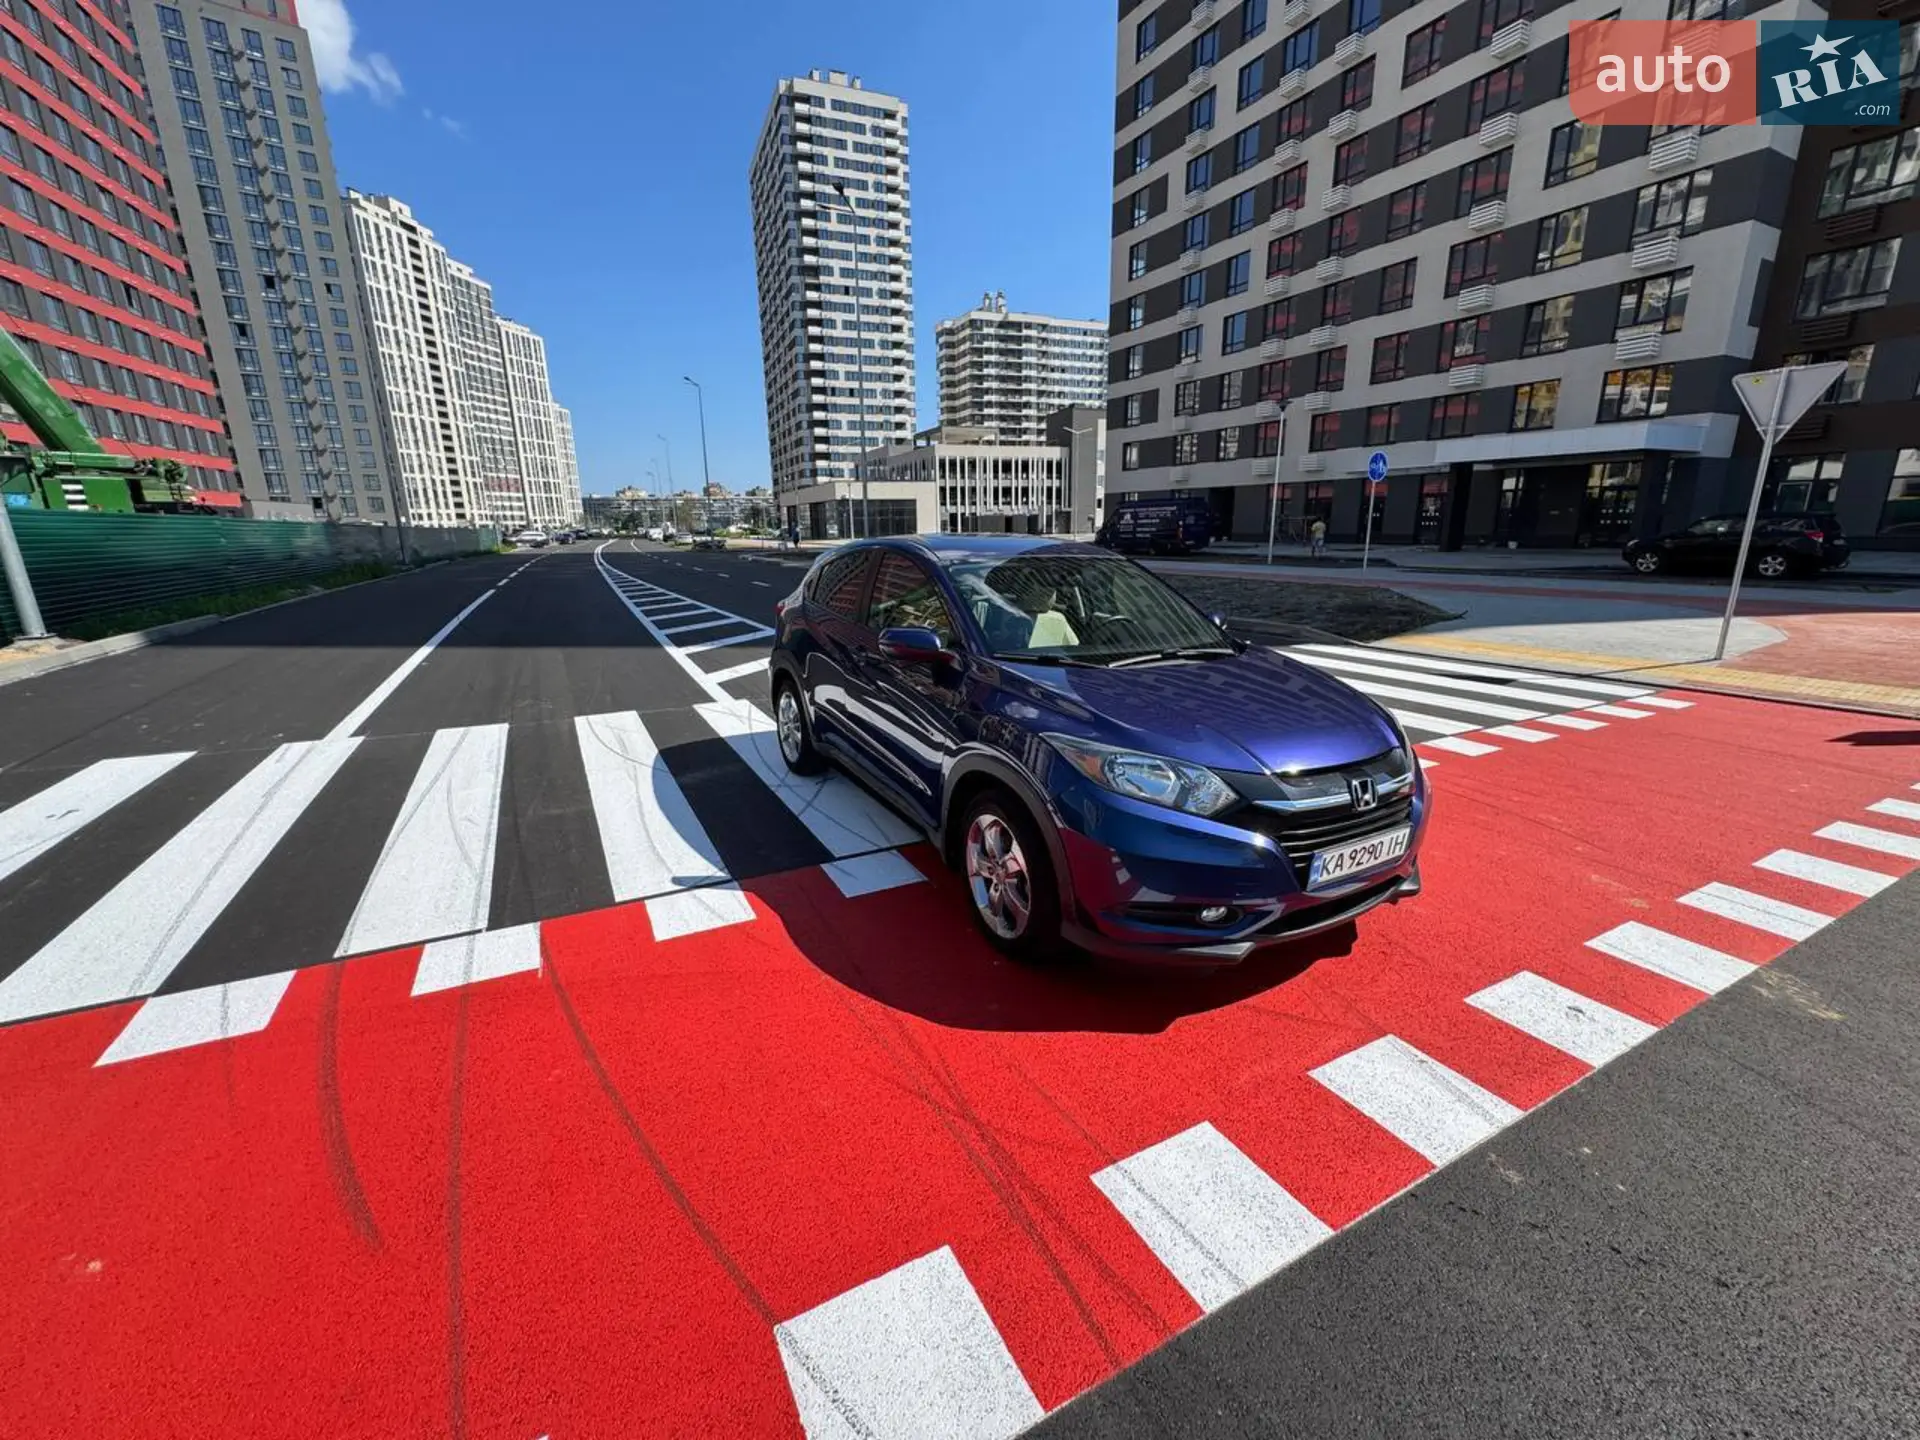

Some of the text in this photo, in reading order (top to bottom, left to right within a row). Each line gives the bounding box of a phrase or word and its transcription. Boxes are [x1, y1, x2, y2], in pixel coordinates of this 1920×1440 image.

[1320, 853, 1344, 877] KA
[1348, 841, 1384, 868] 9290
[1387, 833, 1406, 856] IH
